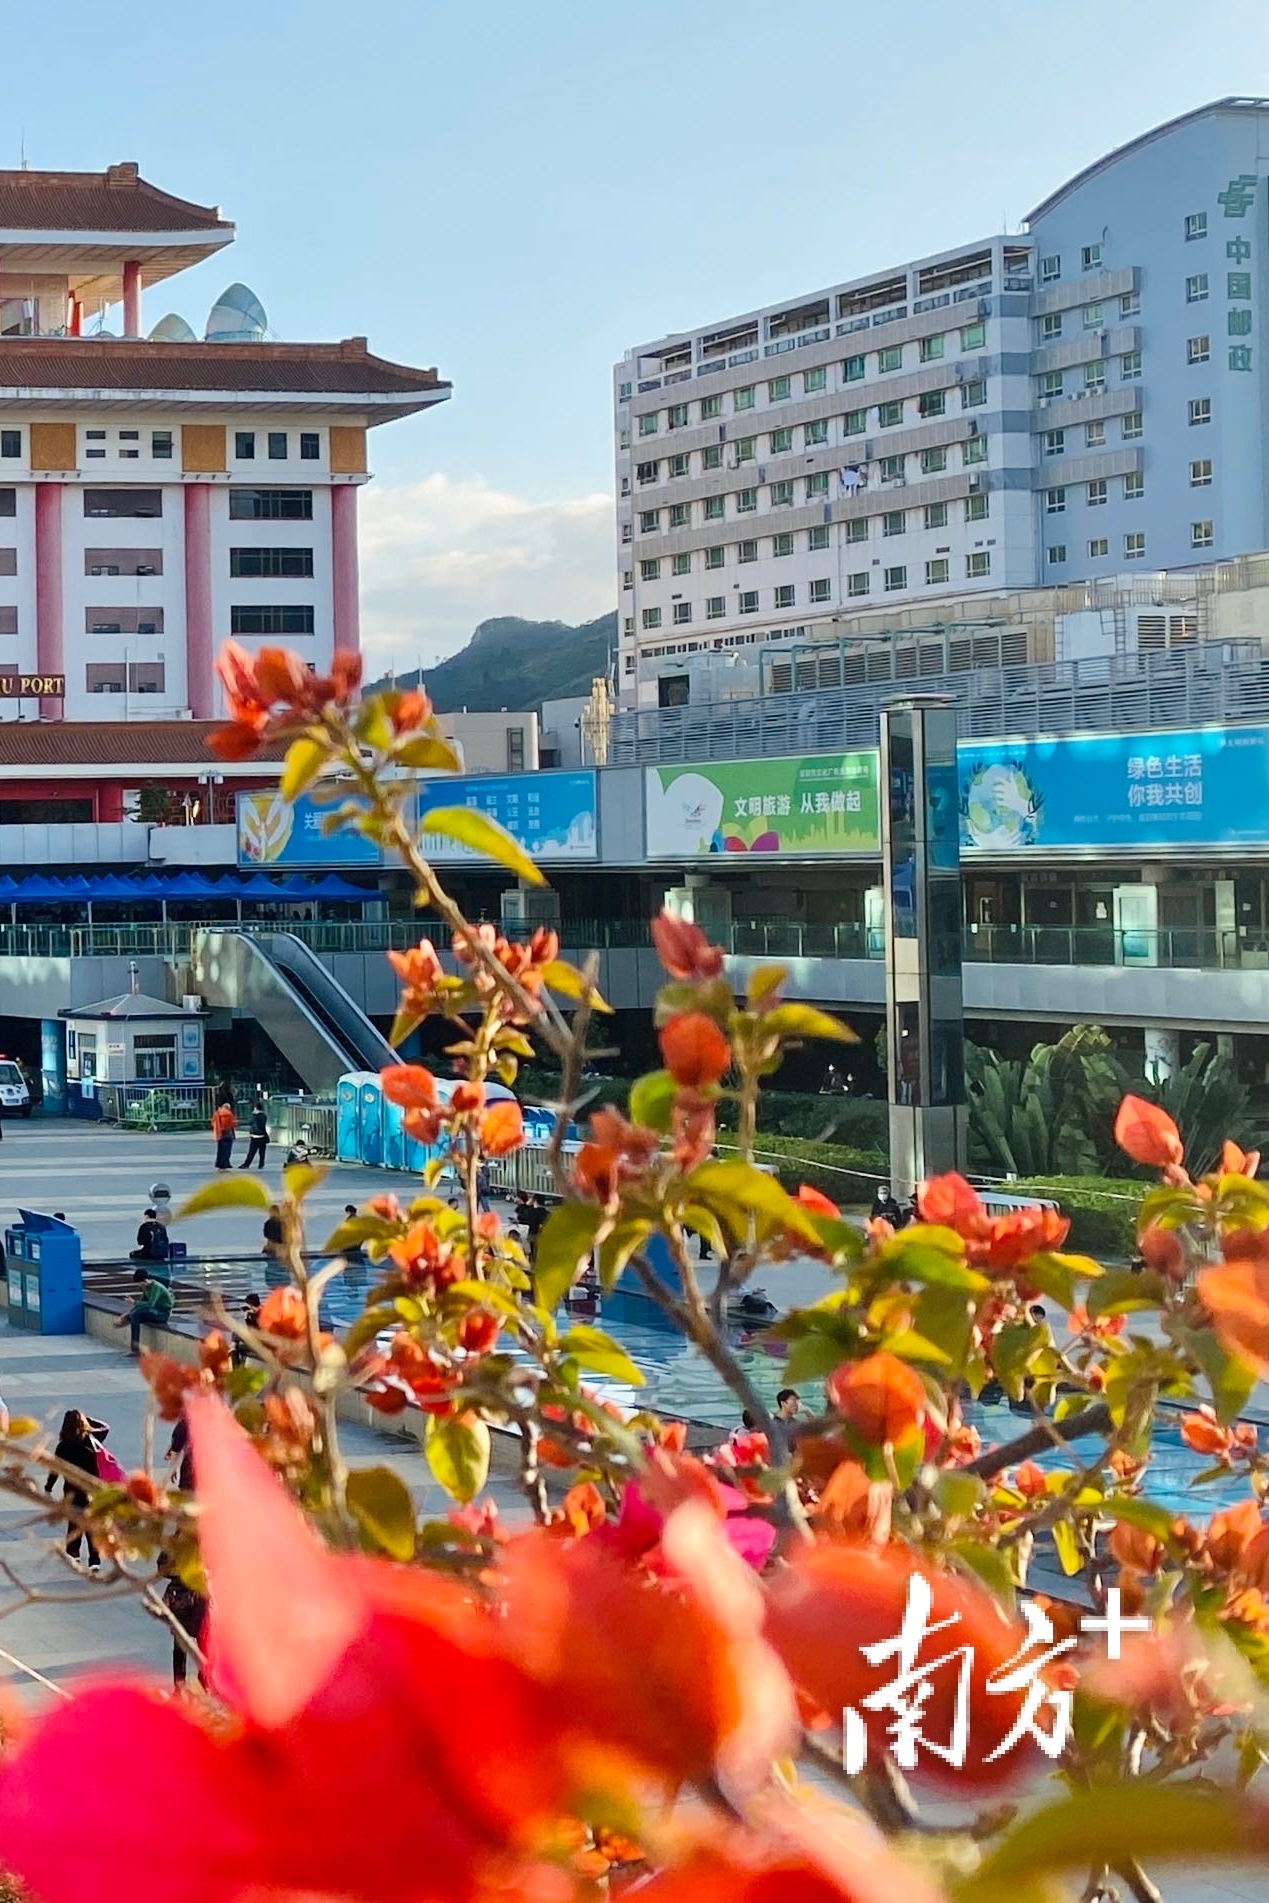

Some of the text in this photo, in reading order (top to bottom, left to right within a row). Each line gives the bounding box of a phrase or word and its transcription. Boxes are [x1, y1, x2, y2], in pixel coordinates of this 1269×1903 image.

[19, 676, 65, 694] PORT
[1126, 753, 1203, 780] 绿色生活
[734, 790, 862, 818] 文明旅游 从我做起
[1127, 780, 1203, 808] 你我共创
